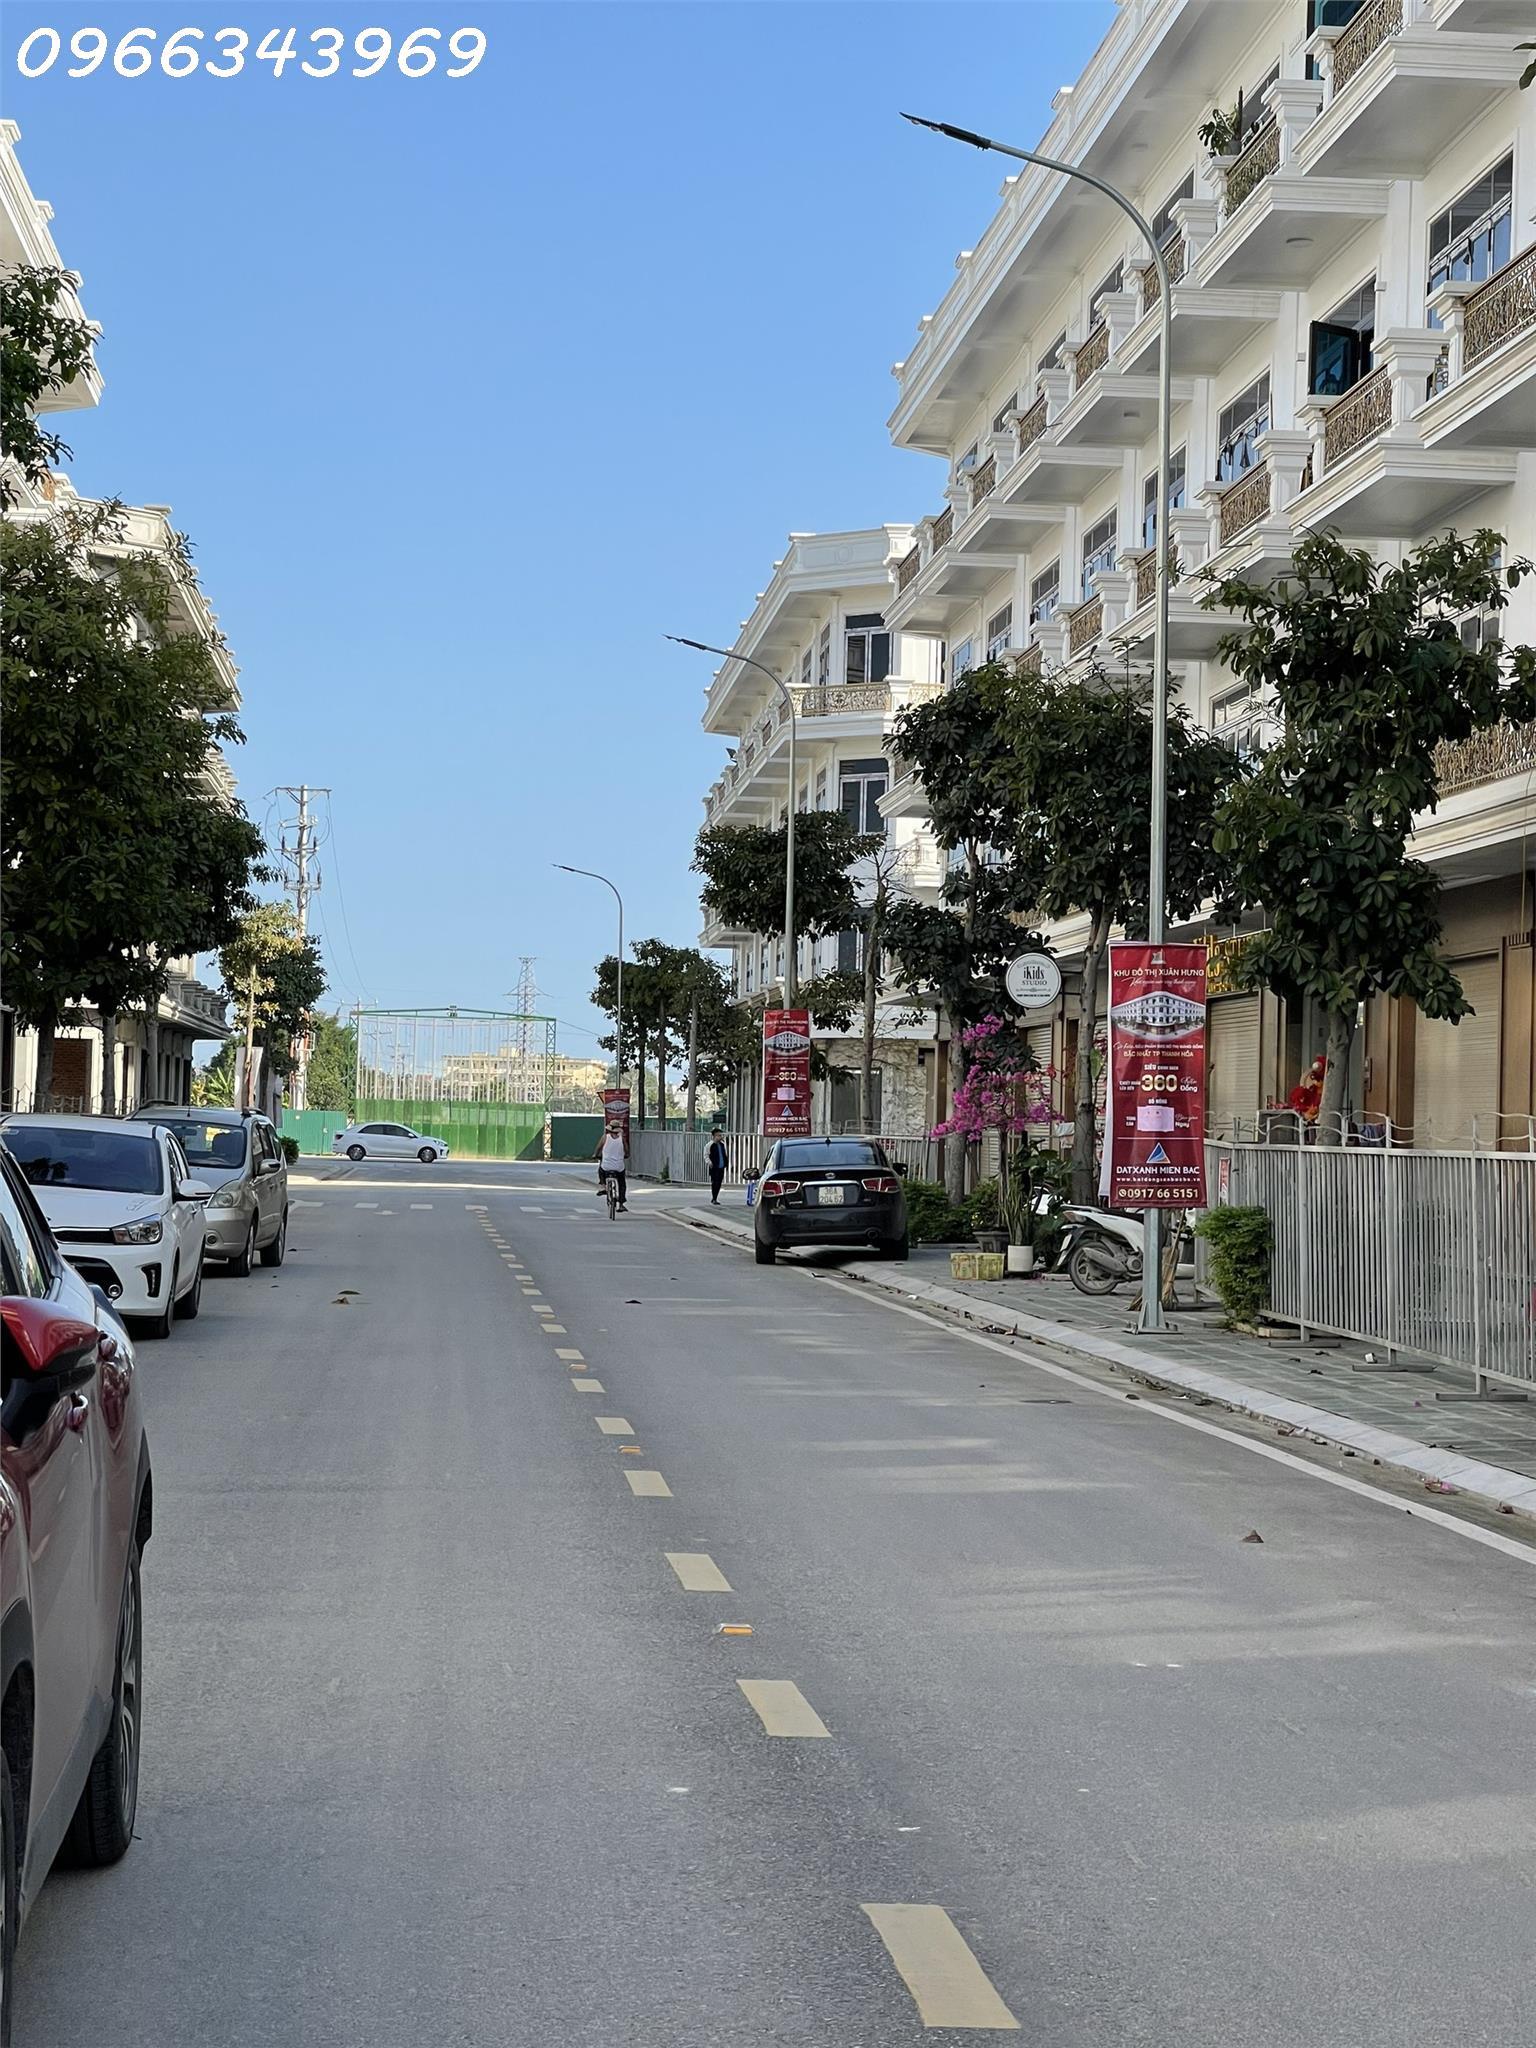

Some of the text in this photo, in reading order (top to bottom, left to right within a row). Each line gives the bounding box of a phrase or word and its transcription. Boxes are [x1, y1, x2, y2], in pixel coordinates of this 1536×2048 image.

[1114, 969, 1130, 977] KHU
[1145, 969, 1157, 978] THỊ
[1181, 969, 1204, 977] HƯNG
[1141, 1074, 1177, 1092] 360
[1116, 1166, 1200, 1174] DATXANH MIEN BAC
[1127, 1188, 1198, 1198] 0917 66 5151
